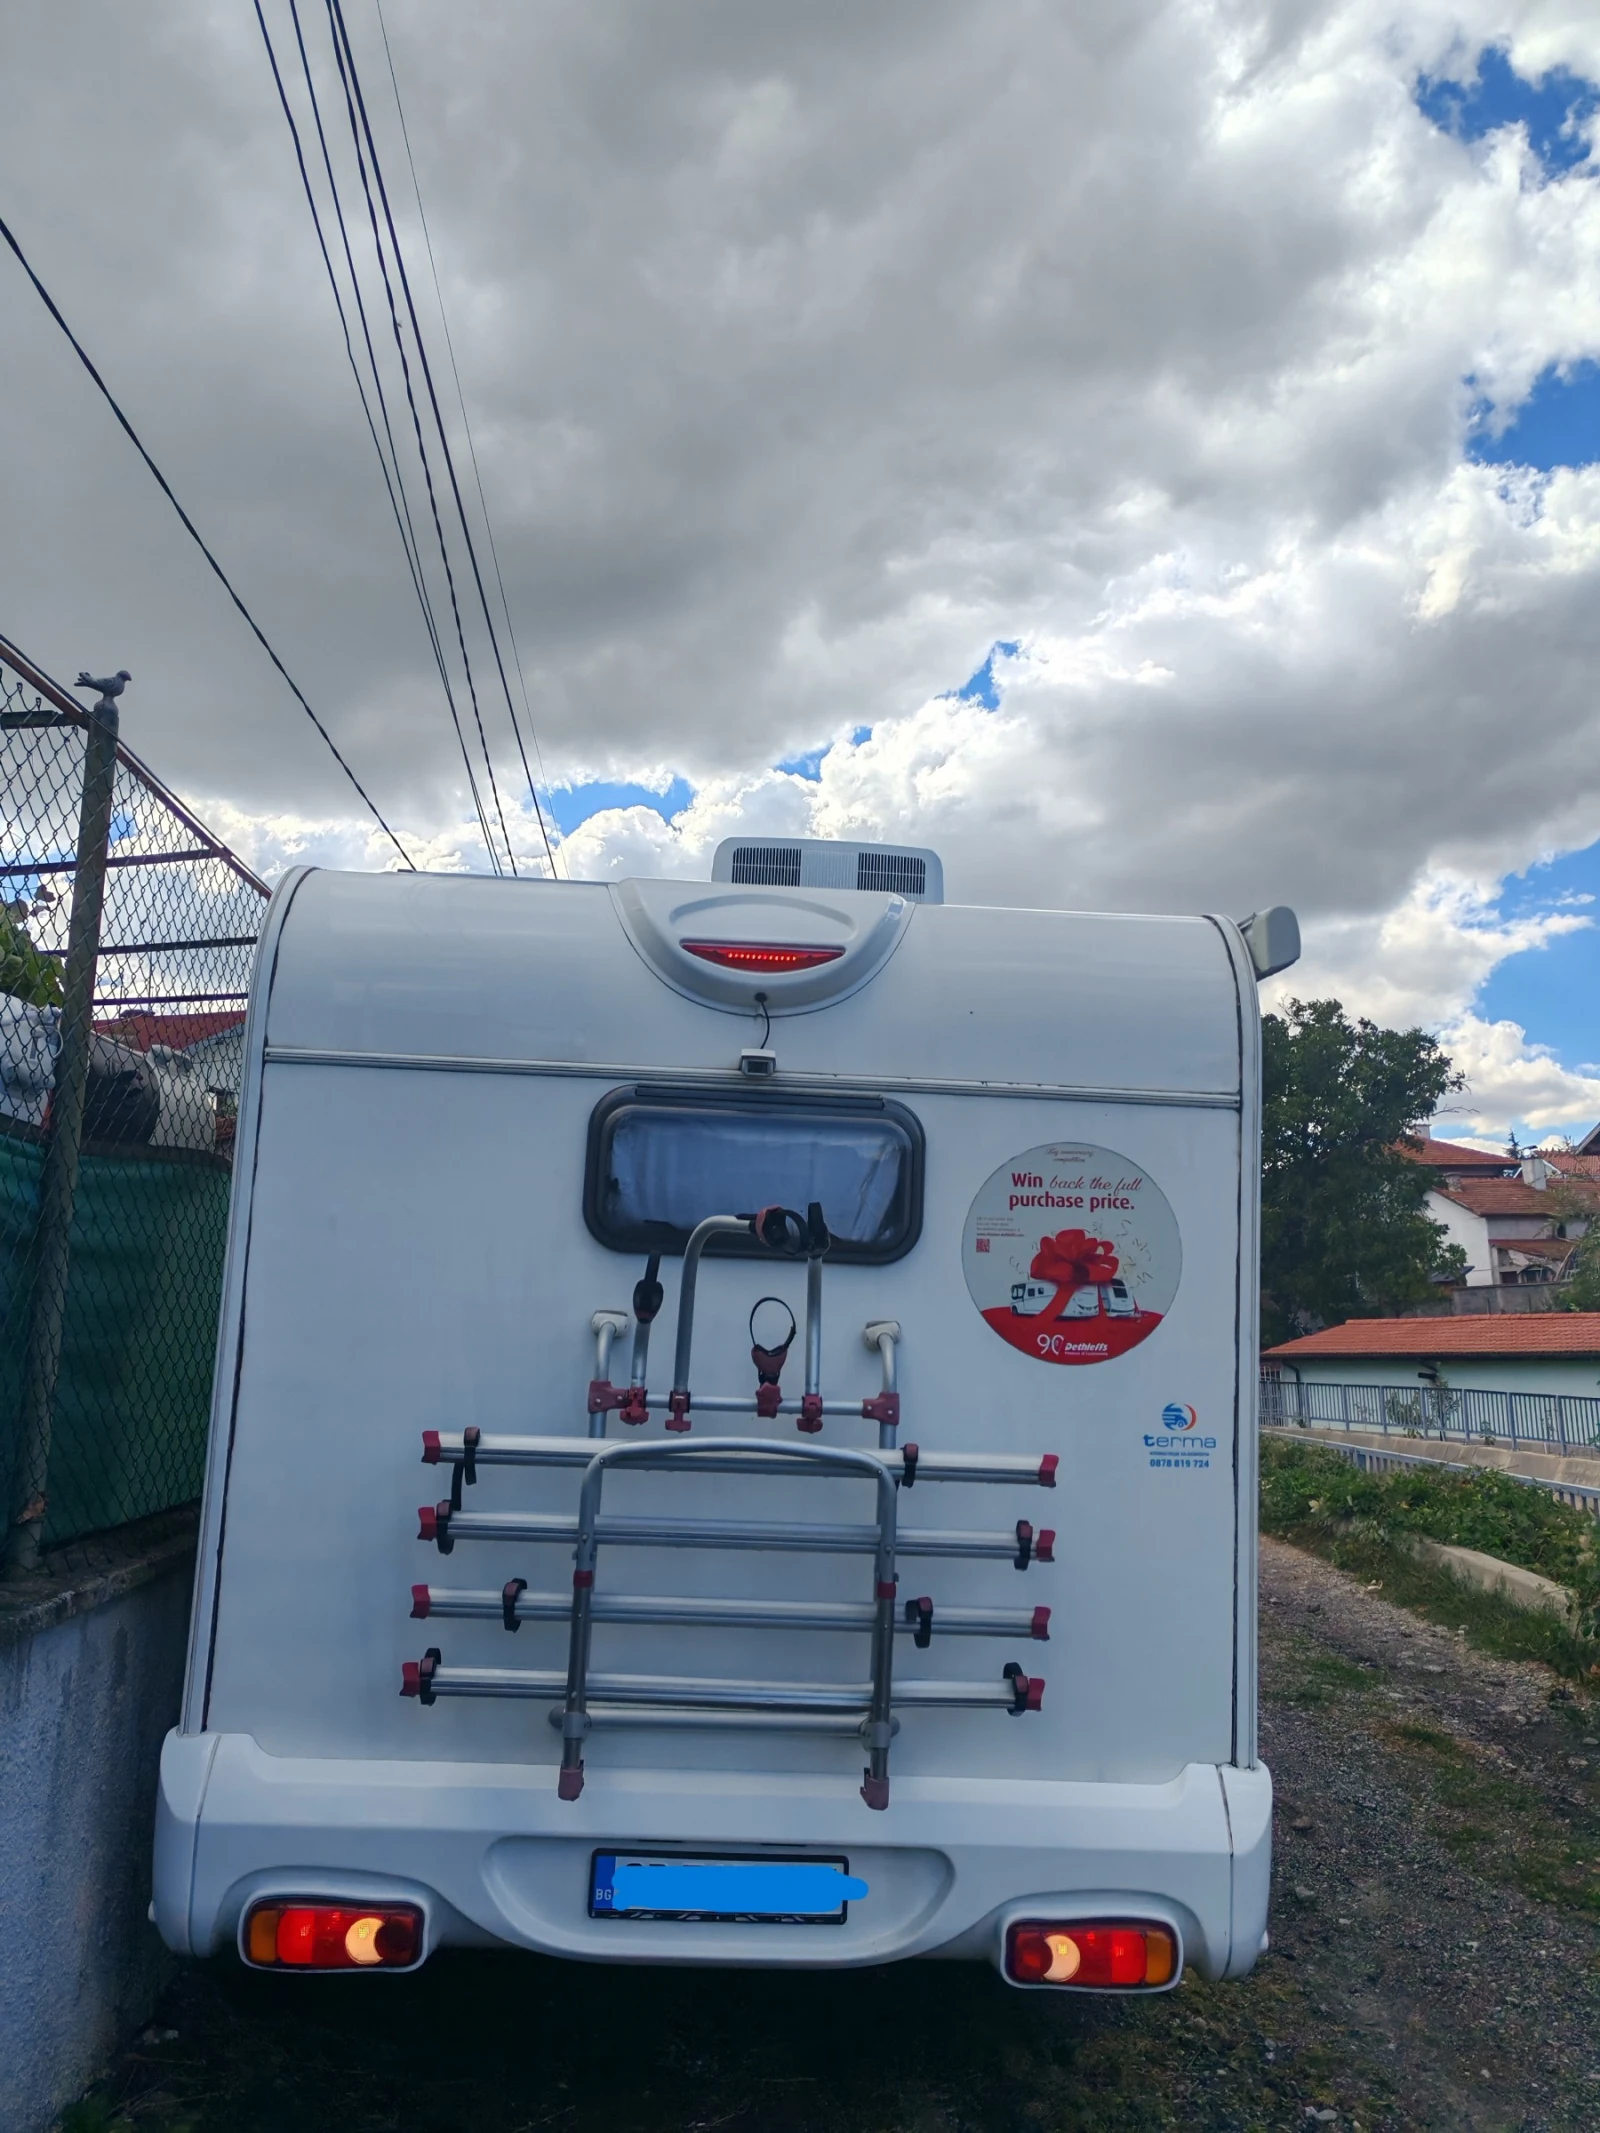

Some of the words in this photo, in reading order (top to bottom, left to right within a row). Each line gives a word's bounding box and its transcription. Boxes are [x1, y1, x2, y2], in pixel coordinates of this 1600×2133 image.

[1011, 1172, 1043, 1188] Win
[1049, 1175, 1085, 1189] back
[1089, 1177, 1113, 1190] the
[1113, 1177, 1143, 1197] full
[1009, 1191, 1084, 1211] purchase
[1089, 1193, 1135, 1213] price.
[1064, 1342, 1108, 1352] Dethleffs
[1143, 1434, 1217, 1449] terma
[595, 1888, 612, 1901] BG
